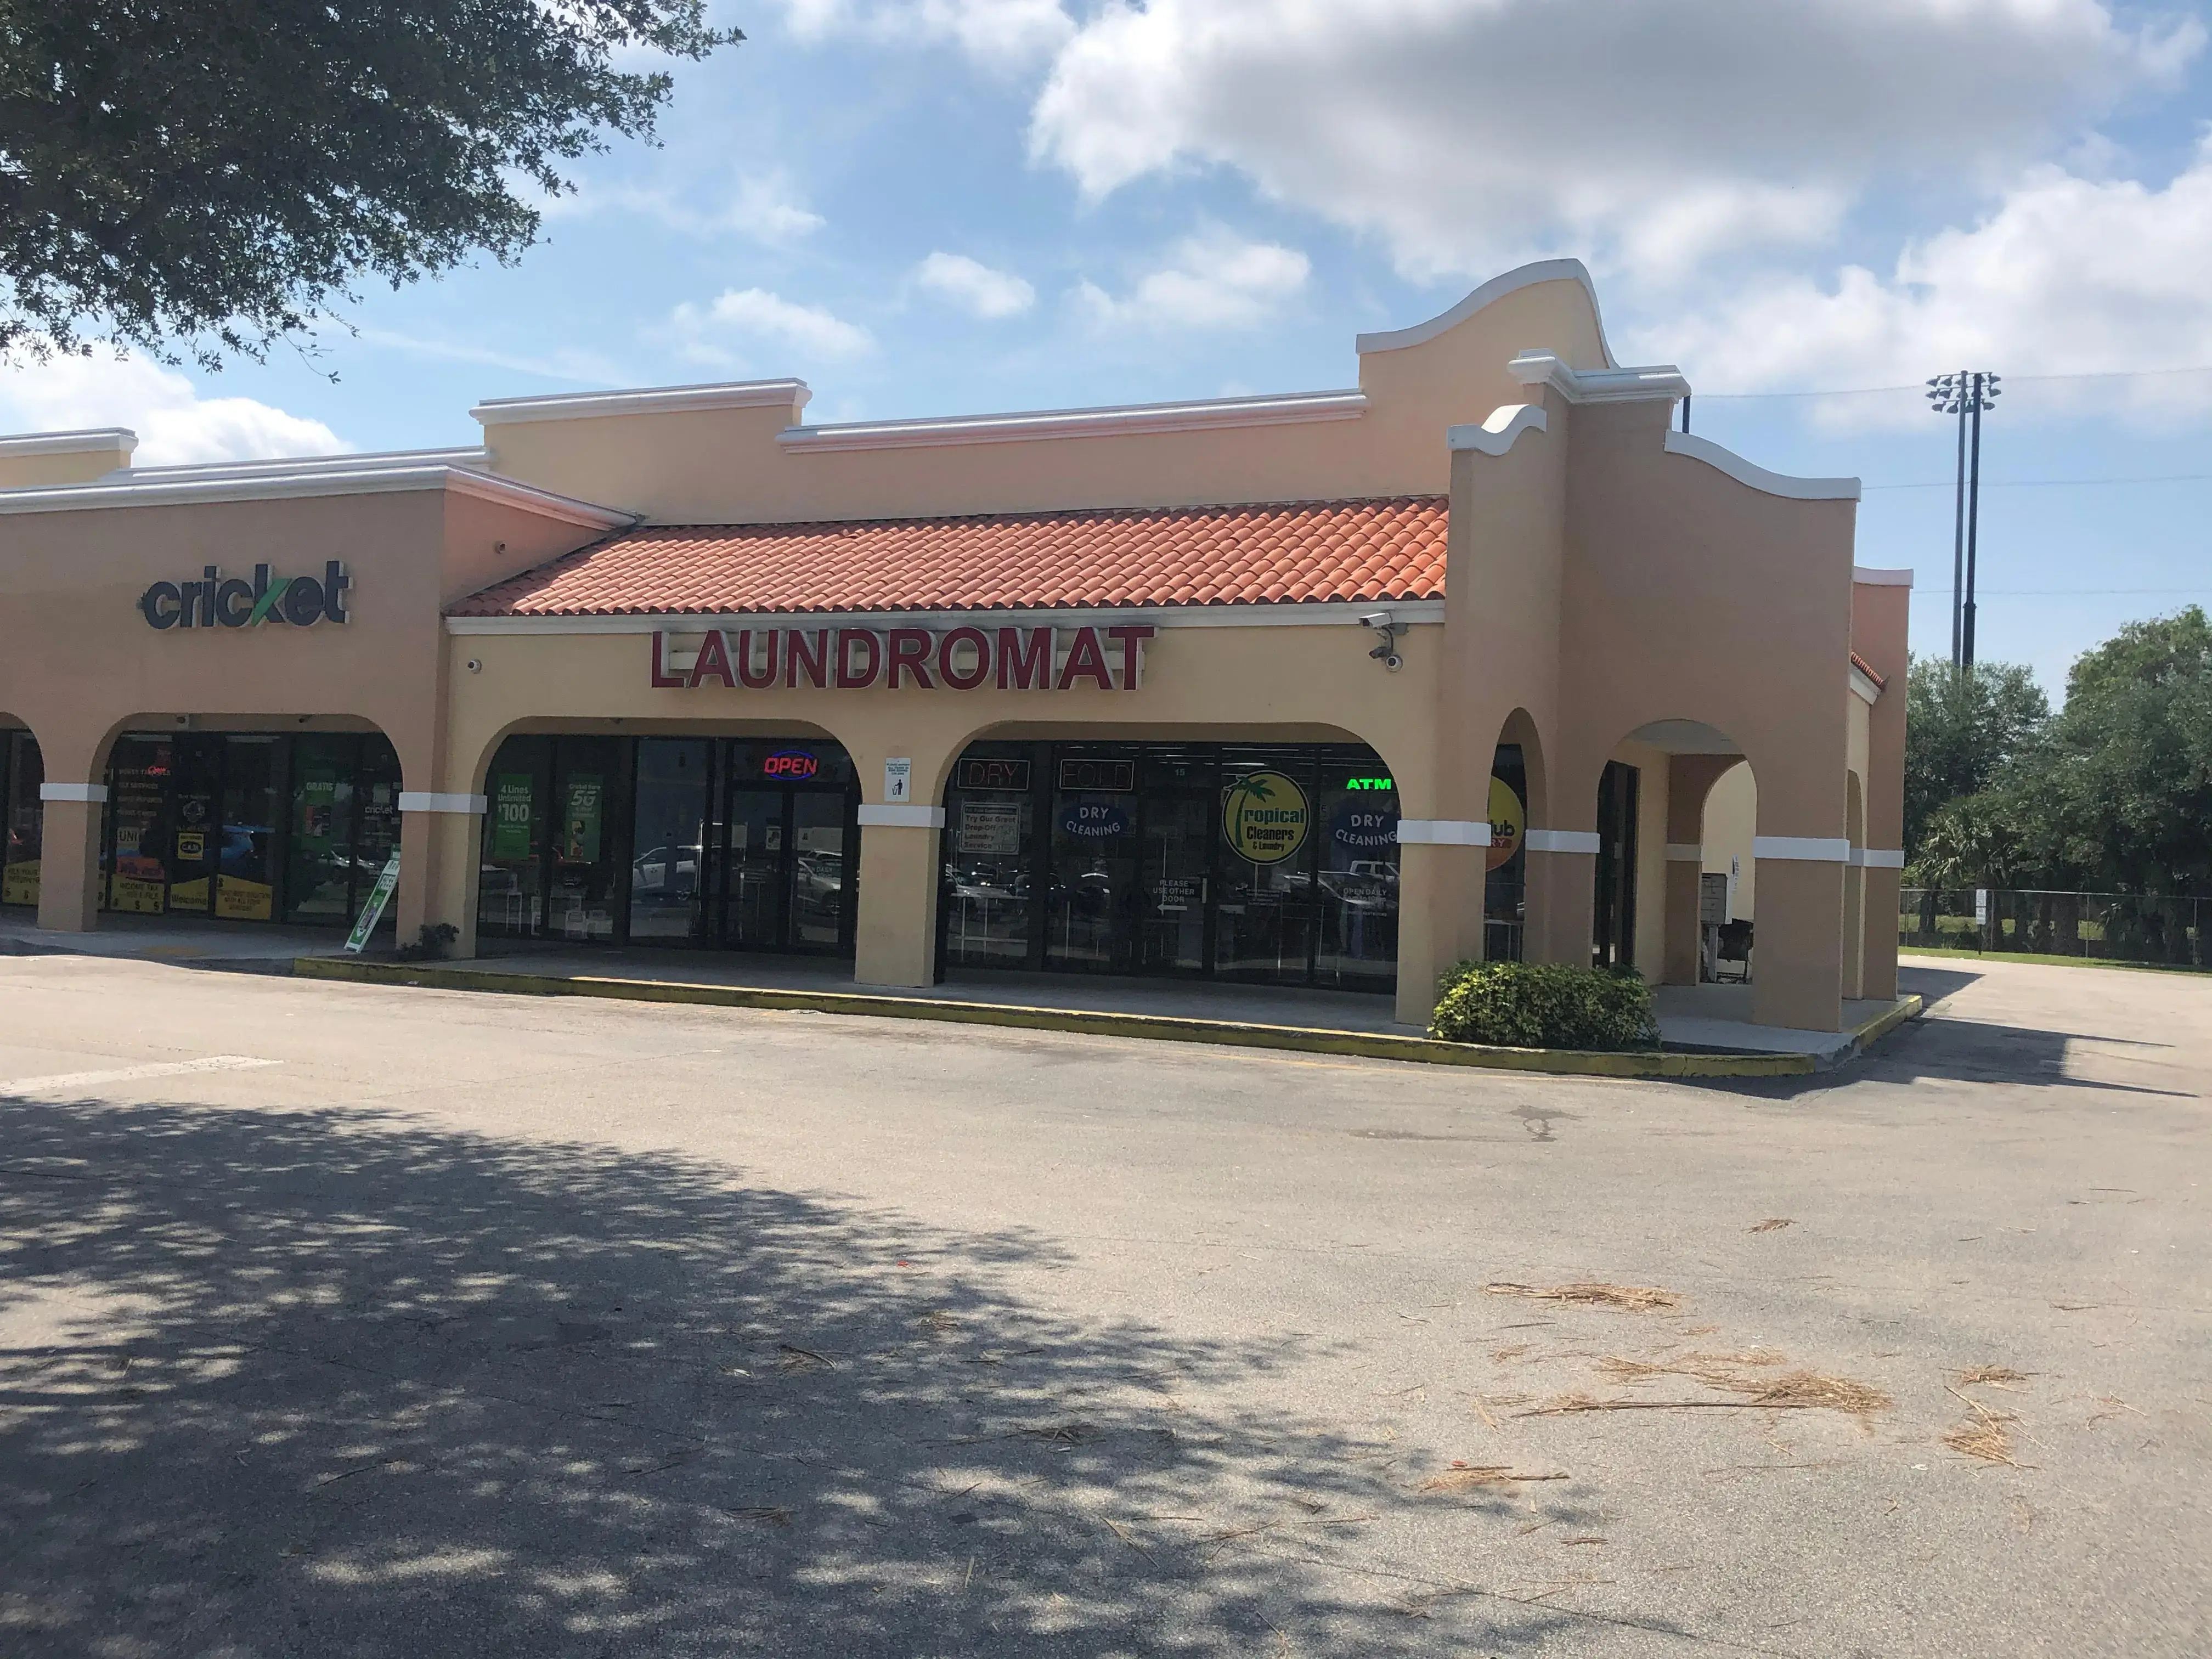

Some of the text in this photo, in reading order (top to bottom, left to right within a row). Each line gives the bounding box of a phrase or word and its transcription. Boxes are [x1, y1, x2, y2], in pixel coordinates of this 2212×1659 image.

[143, 560, 351, 629] cricket
[650, 626, 1155, 691] LAUNDROMAT
[764, 757, 818, 775] OPEN
[969, 762, 1020, 786] DRY
[1063, 763, 1131, 787] FOLD
[500, 785, 529, 794] 4 Lines
[1346, 778, 1392, 790] ATM
[498, 794, 531, 802] Unlimited
[571, 790, 597, 807] 5G
[498, 804, 529, 822] $100
[1079, 806, 1109, 820] DRY
[1066, 820, 1121, 837] CLEANING
[1350, 814, 1385, 828] DRY
[1246, 826, 1295, 840] Cleaners
[1335, 828, 1397, 847] CLEANING
[1259, 842, 1285, 852] Laundry
[1343, 887, 1387, 896] OPEN DAILY
[172, 894, 206, 905] Welcome
